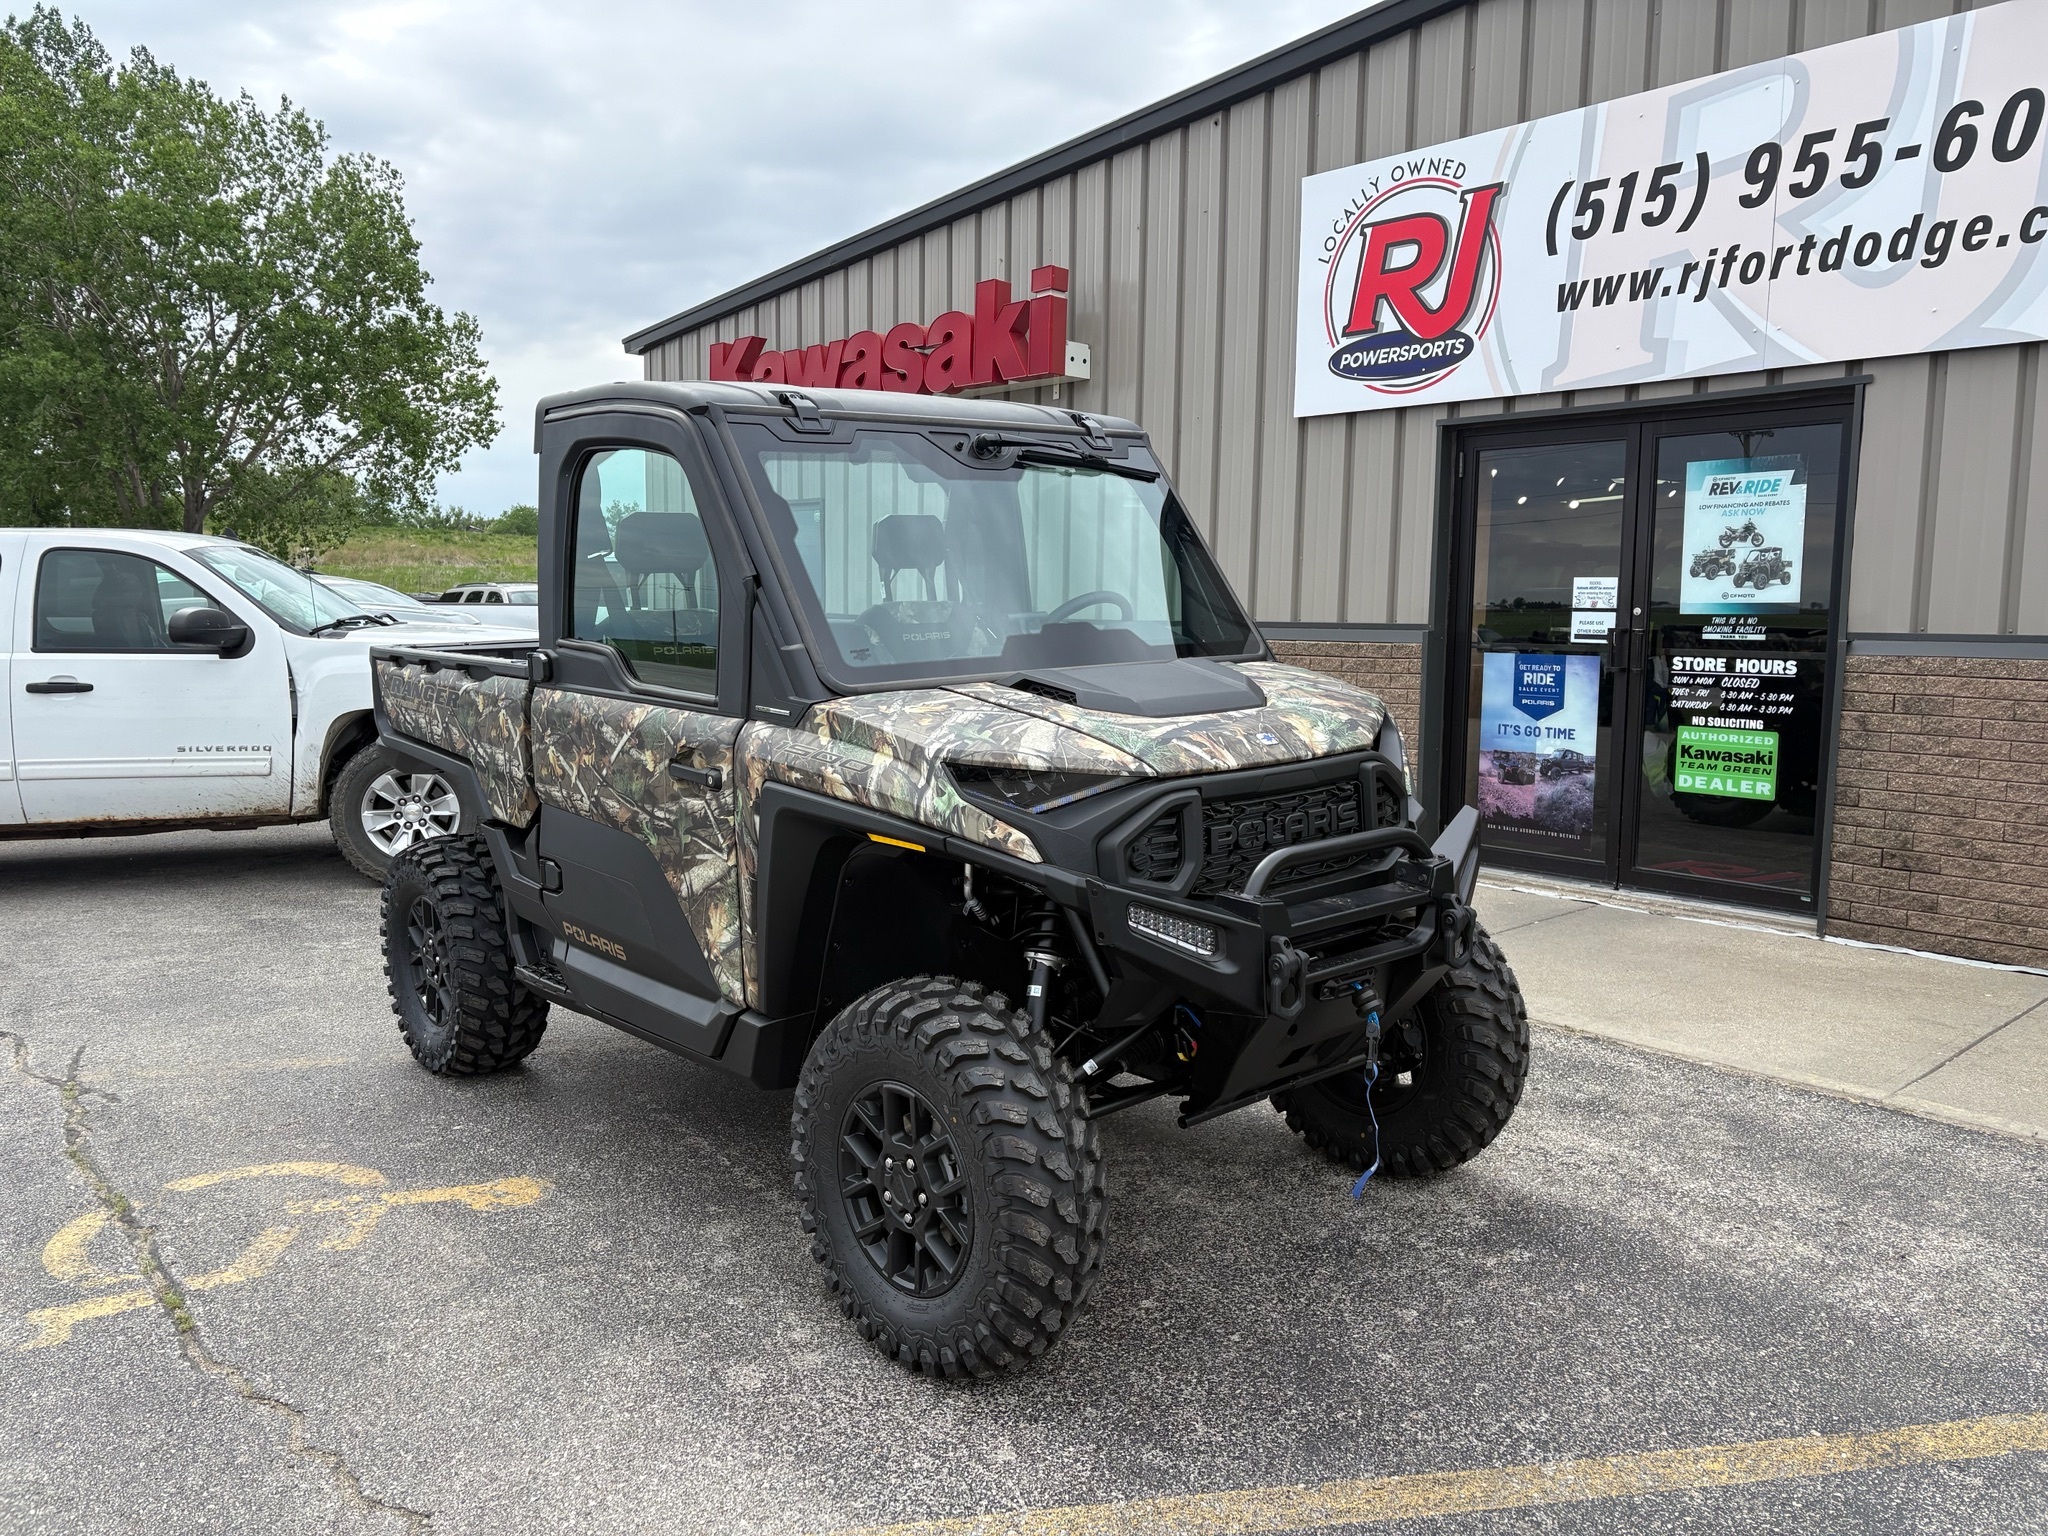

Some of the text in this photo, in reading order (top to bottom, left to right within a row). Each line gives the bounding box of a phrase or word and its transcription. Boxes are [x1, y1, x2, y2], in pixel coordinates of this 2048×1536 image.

[1545, 87, 2046, 256] (515) 955-60
[1318, 158, 1466, 264] LOCALLY OWNED
[1341, 181, 1506, 340] RJ
[1556, 205, 2048, 312] www.rjfortdodge.c
[710, 264, 1069, 393] Kawasaki
[1339, 338, 1466, 369] POWERSPORTS
[1721, 508, 1766, 517] ASK NOW
[1711, 616, 1726, 624] THIS
[1729, 616, 1736, 624] IS
[903, 631, 951, 642] POLARIS
[1702, 625, 1767, 634] SMOKING FACILITY
[653, 646, 714, 655] POLARIS
[1672, 656, 1798, 675] STORE HOURS
[1523, 672, 1556, 686] RIDE
[1672, 676, 1689, 684] SUN
[1695, 676, 1715, 685] MON
[1721, 677, 1760, 688] CLOSED
[390, 675, 461, 710] RANGER
[1671, 688, 1690, 696] TUES
[1696, 689, 1710, 697] FRI
[1738, 691, 1754, 699] AM
[1778, 693, 1794, 702] PM
[1671, 700, 1712, 709] SATURDAY
[1737, 703, 1753, 712] AM
[1777, 706, 1794, 714] PM
[1692, 716, 1764, 729] NO SOLICITING
[1498, 723, 1576, 740] IT'S GO TIME
[1682, 731, 1774, 745] AUTHORIZED
[1680, 745, 1773, 766] Kawasaki
[1680, 761, 1772, 776] TEAM GREEN
[1679, 774, 1772, 795] DEALER
[1210, 800, 1359, 854] POLARIS
[1520, 827, 1546, 836] ASSOCIATE
[1559, 832, 1580, 840] DETAILS
[562, 920, 627, 961] POLARIS
